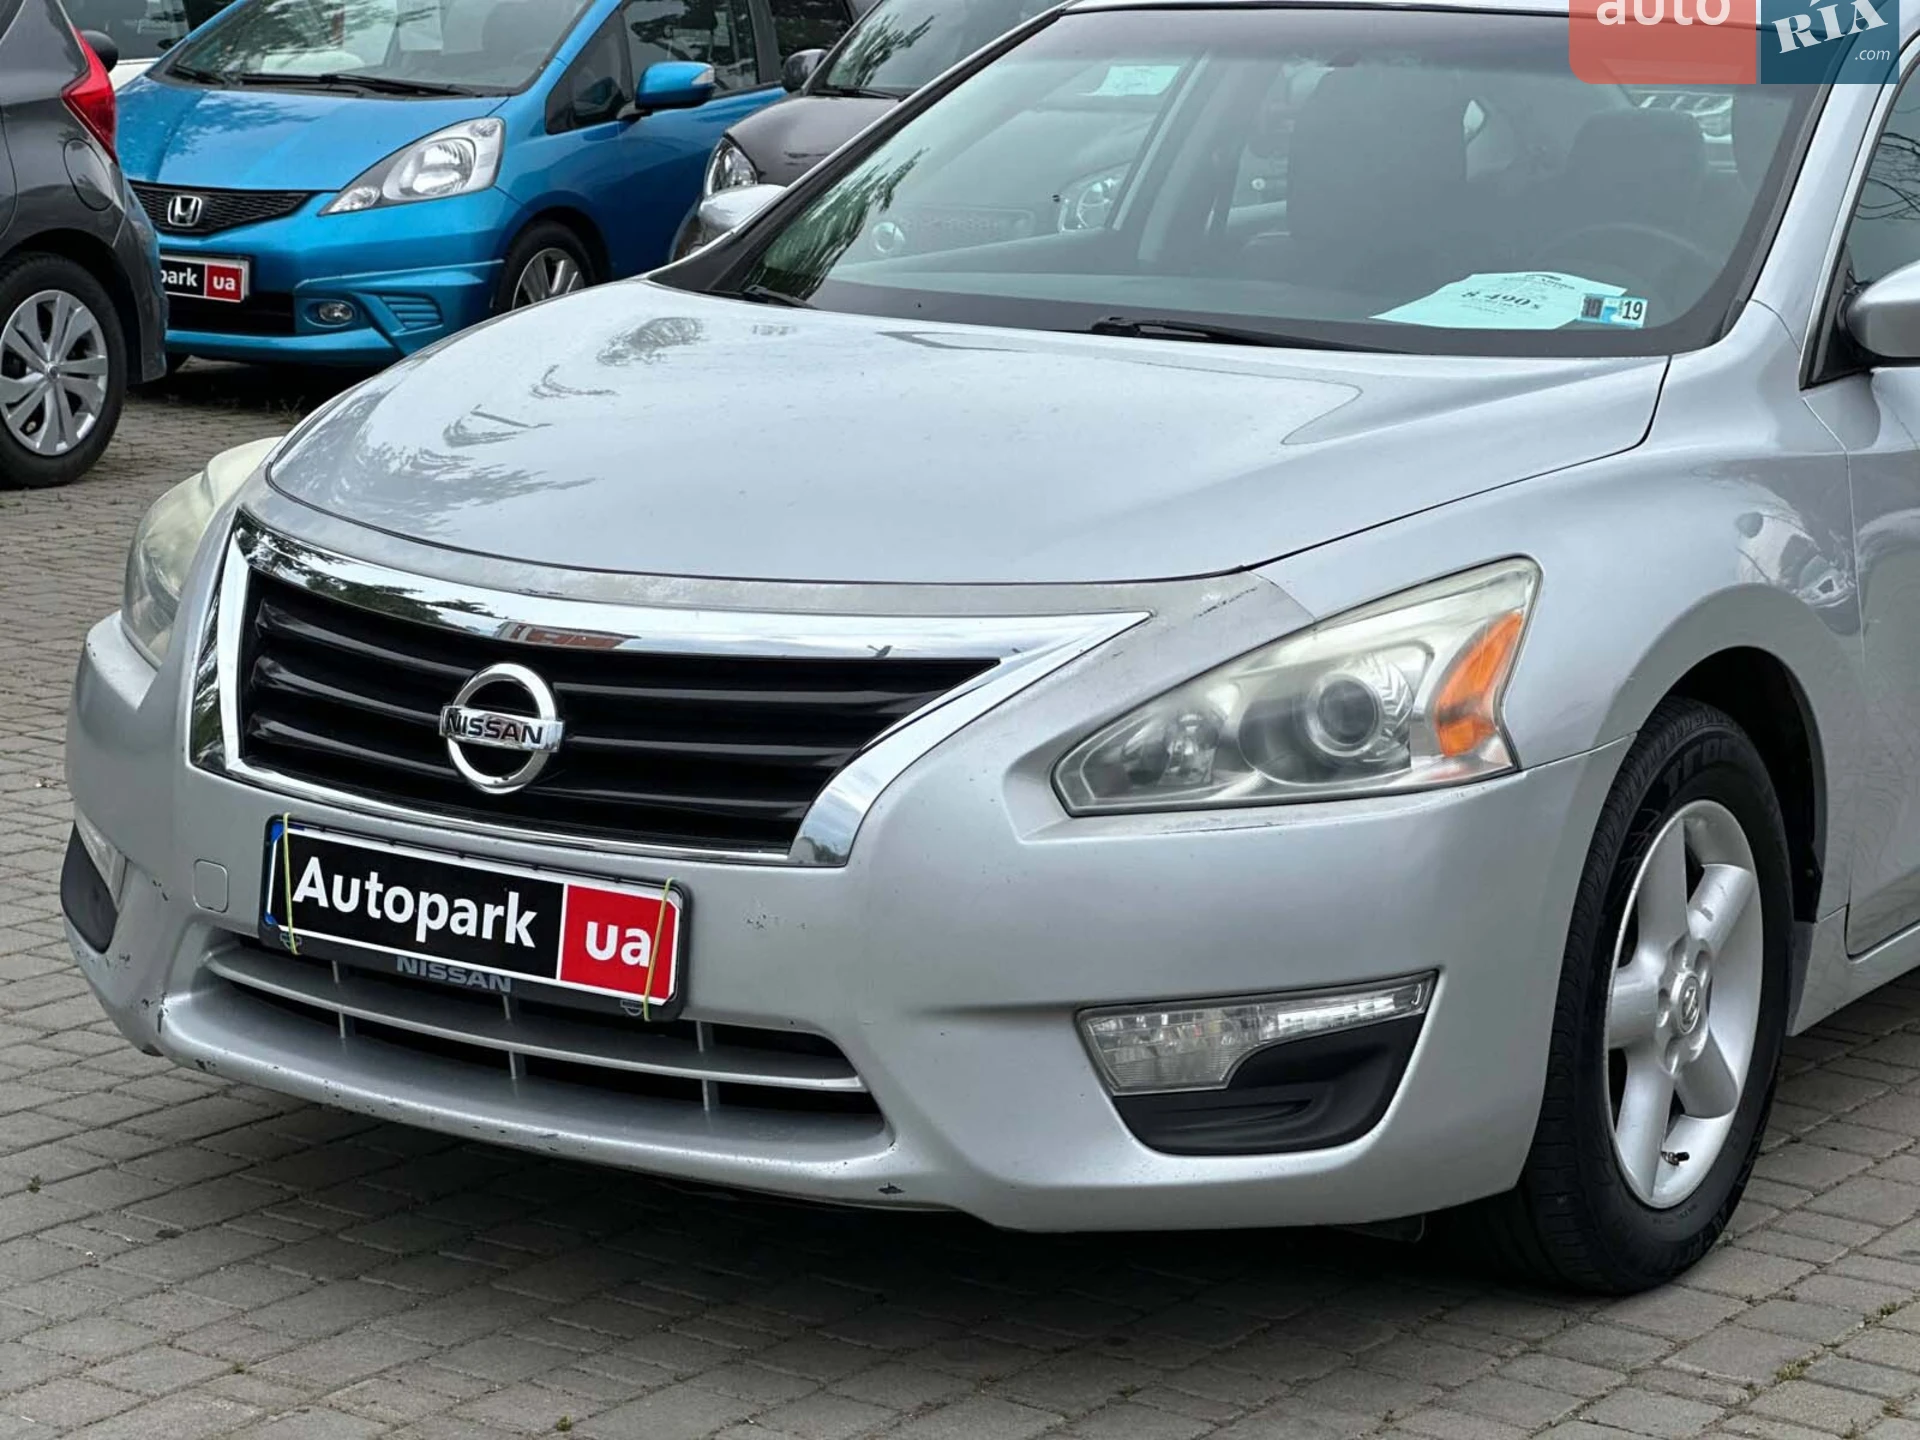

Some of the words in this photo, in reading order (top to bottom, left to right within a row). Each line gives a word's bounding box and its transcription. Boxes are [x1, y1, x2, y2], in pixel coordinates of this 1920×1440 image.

[212, 275, 236, 291] ua
[1622, 300, 1643, 320] 19
[446, 708, 544, 744] NISSAN
[292, 856, 537, 948] Autopark
[585, 920, 653, 968] ua
[396, 955, 512, 993] NISSAN
